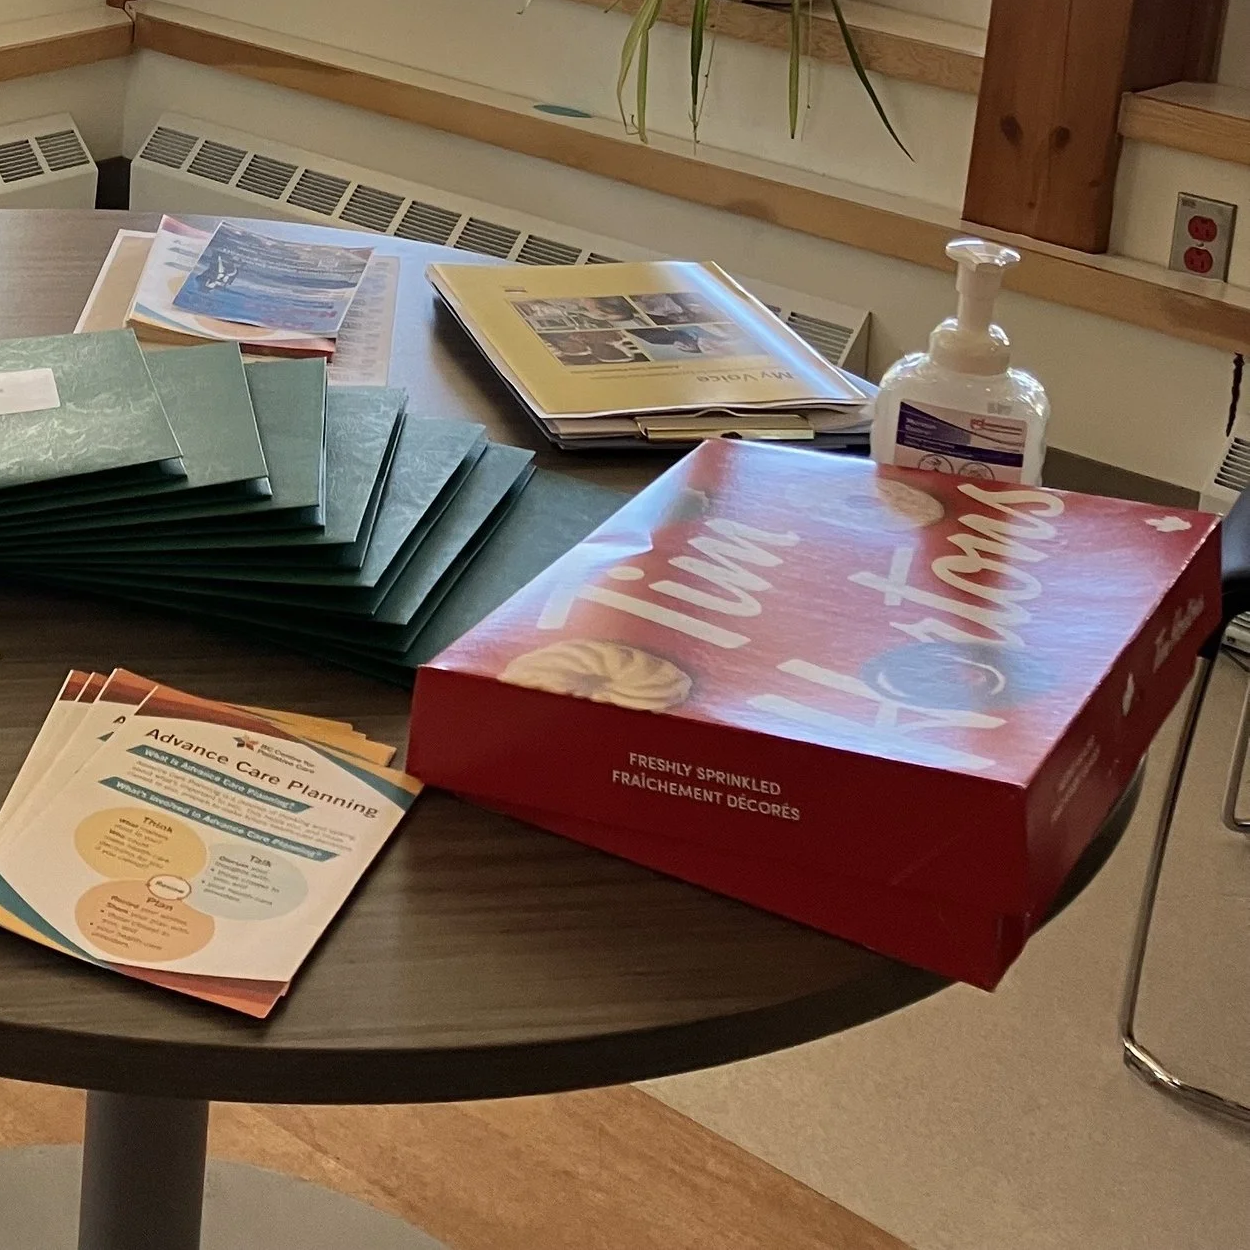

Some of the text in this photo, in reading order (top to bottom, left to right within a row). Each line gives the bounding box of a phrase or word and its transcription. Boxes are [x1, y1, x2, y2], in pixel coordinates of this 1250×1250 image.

[535, 515, 801, 652] Tim
[144, 728, 229, 765] Advance
[235, 760, 282, 786] Care
[287, 778, 379, 819] Planning
[629, 752, 781, 795] FRESHLY SPRINKLED
[727, 793, 800, 821] DÉCORÉS
